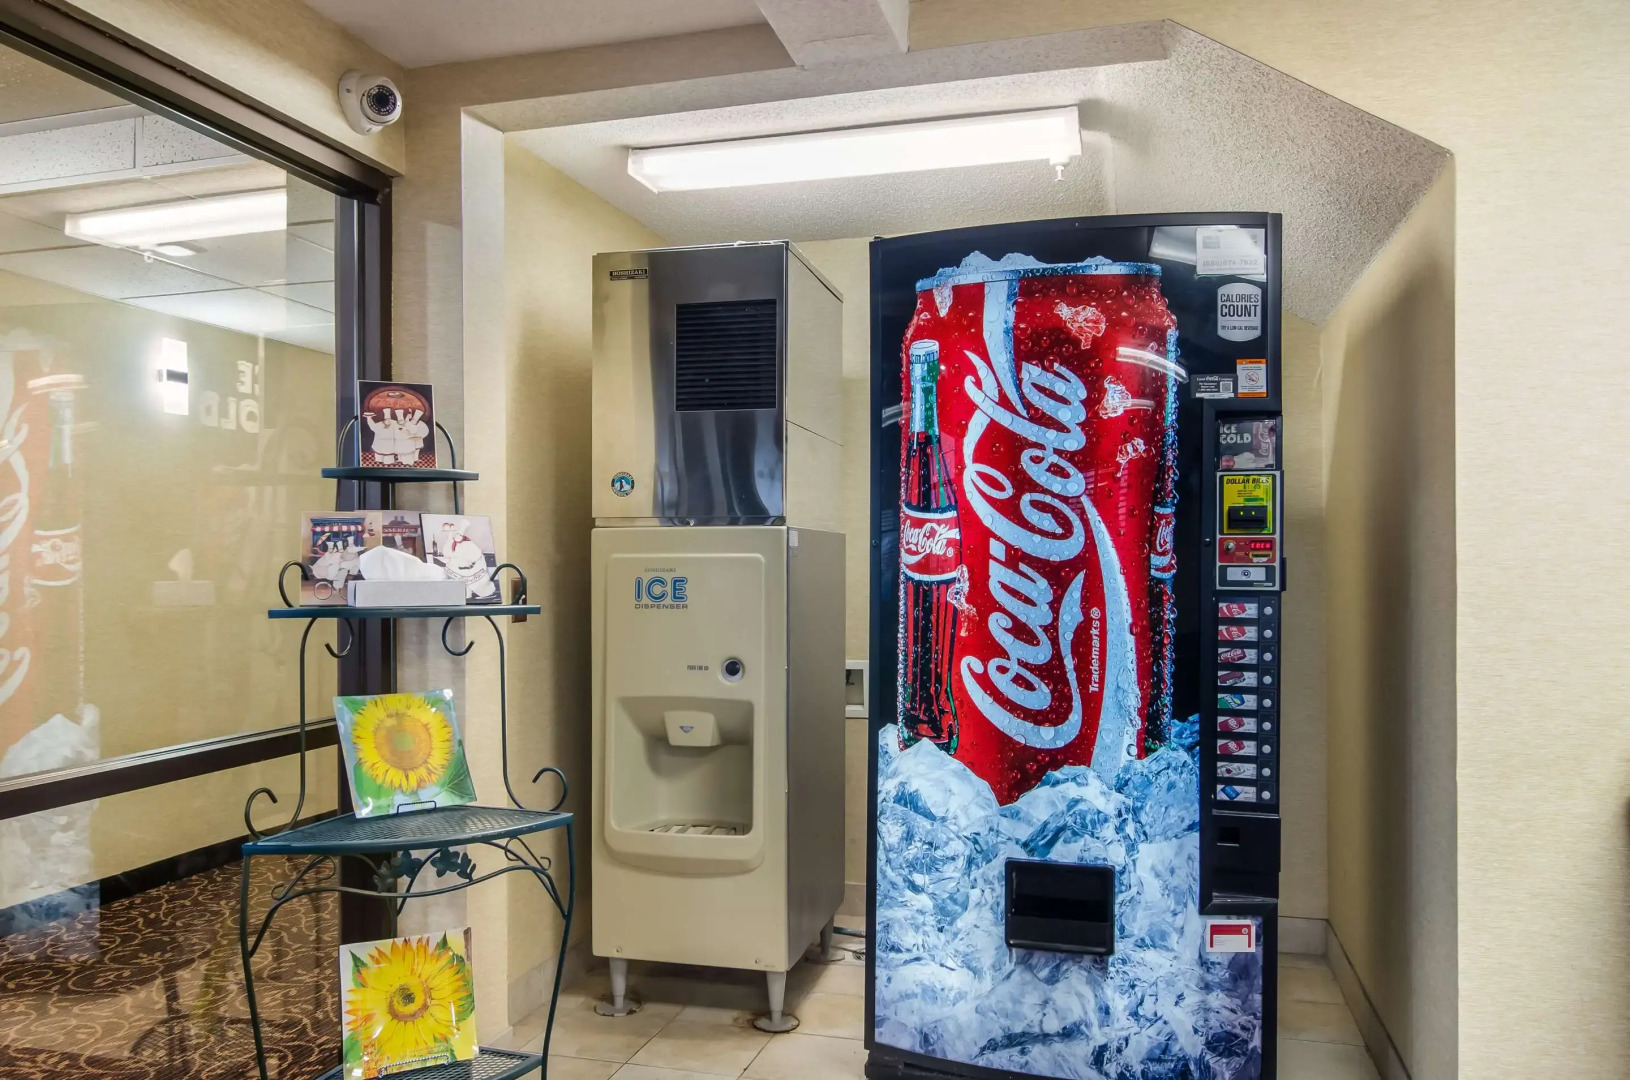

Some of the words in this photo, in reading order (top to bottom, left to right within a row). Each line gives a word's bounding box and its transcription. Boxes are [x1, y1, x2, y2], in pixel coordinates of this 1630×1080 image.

[1220, 293, 1259, 303] CALORIES
[1220, 303, 1259, 318] COUNT
[1219, 423, 1237, 434] ICE
[1219, 432, 1252, 444] COLD
[961, 350, 1088, 750] Coca-Cola
[634, 576, 688, 603] ICE
